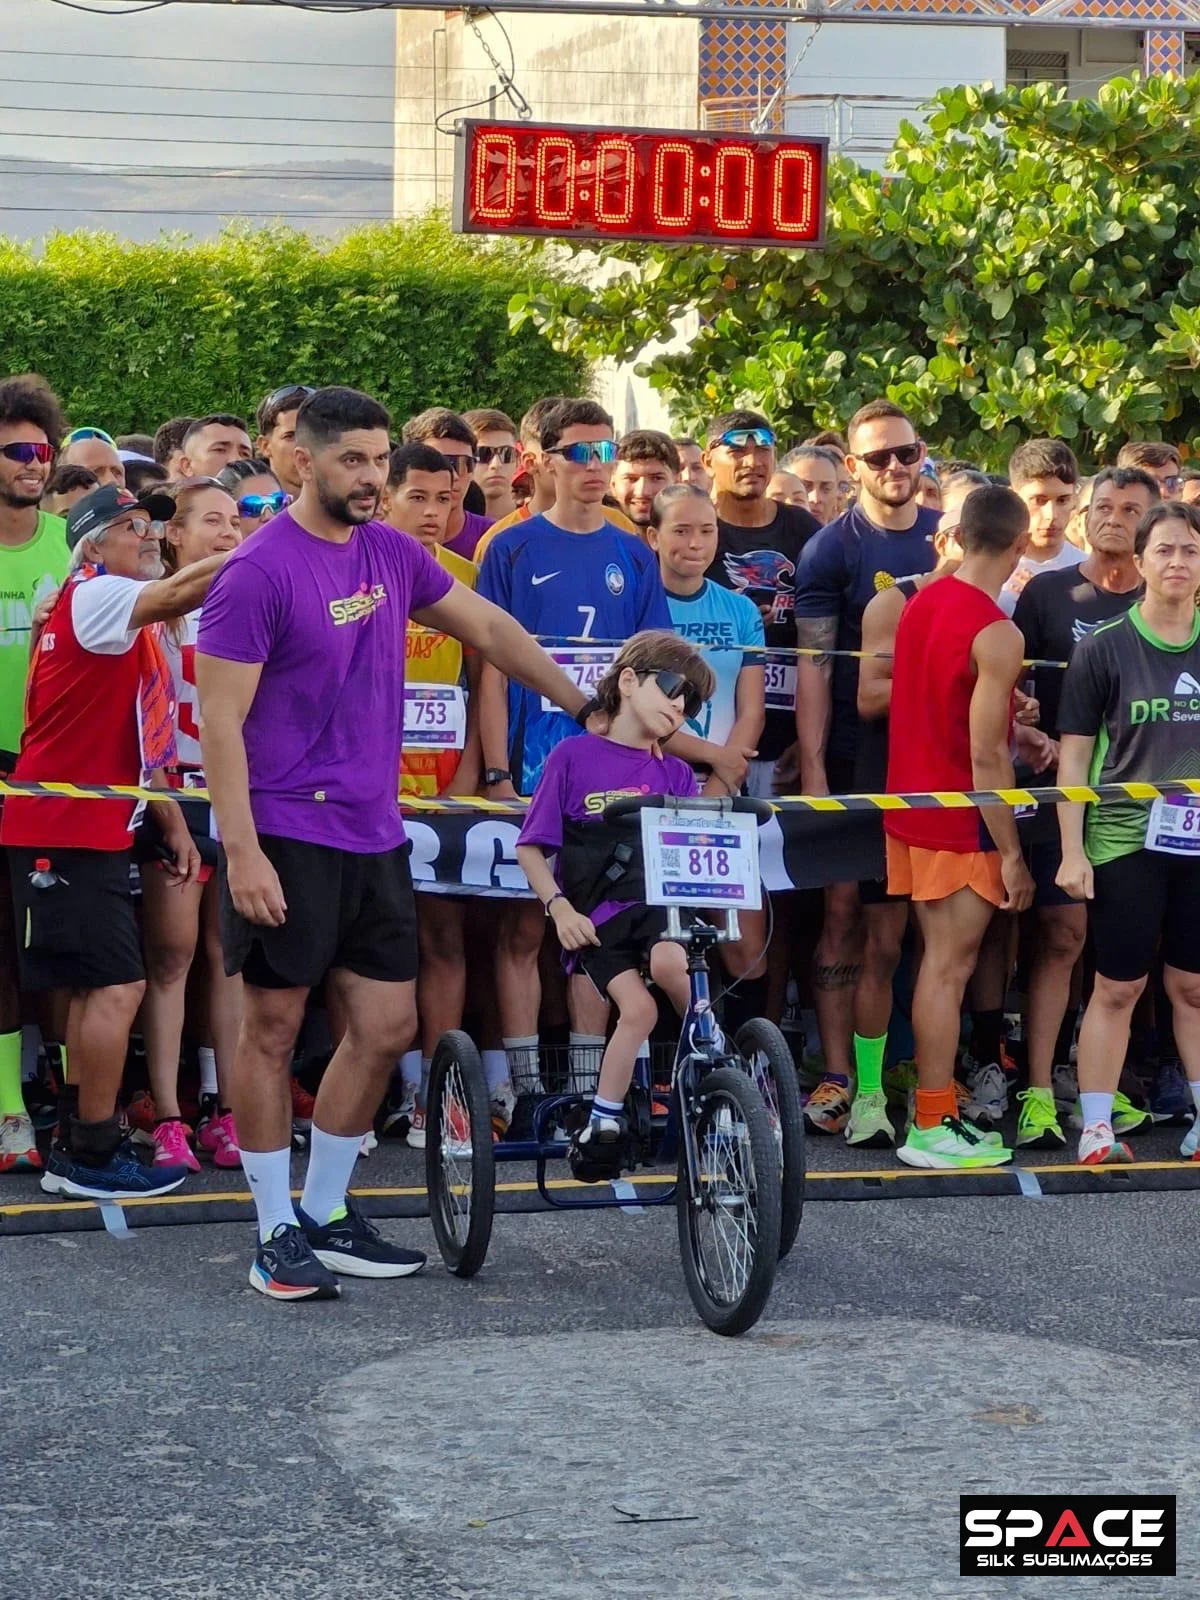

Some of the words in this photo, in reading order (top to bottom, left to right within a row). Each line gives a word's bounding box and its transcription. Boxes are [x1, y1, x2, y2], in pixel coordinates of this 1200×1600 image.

[414, 701, 447, 725] 753
[1131, 698, 1170, 725] DR
[688, 848, 730, 877] 818
